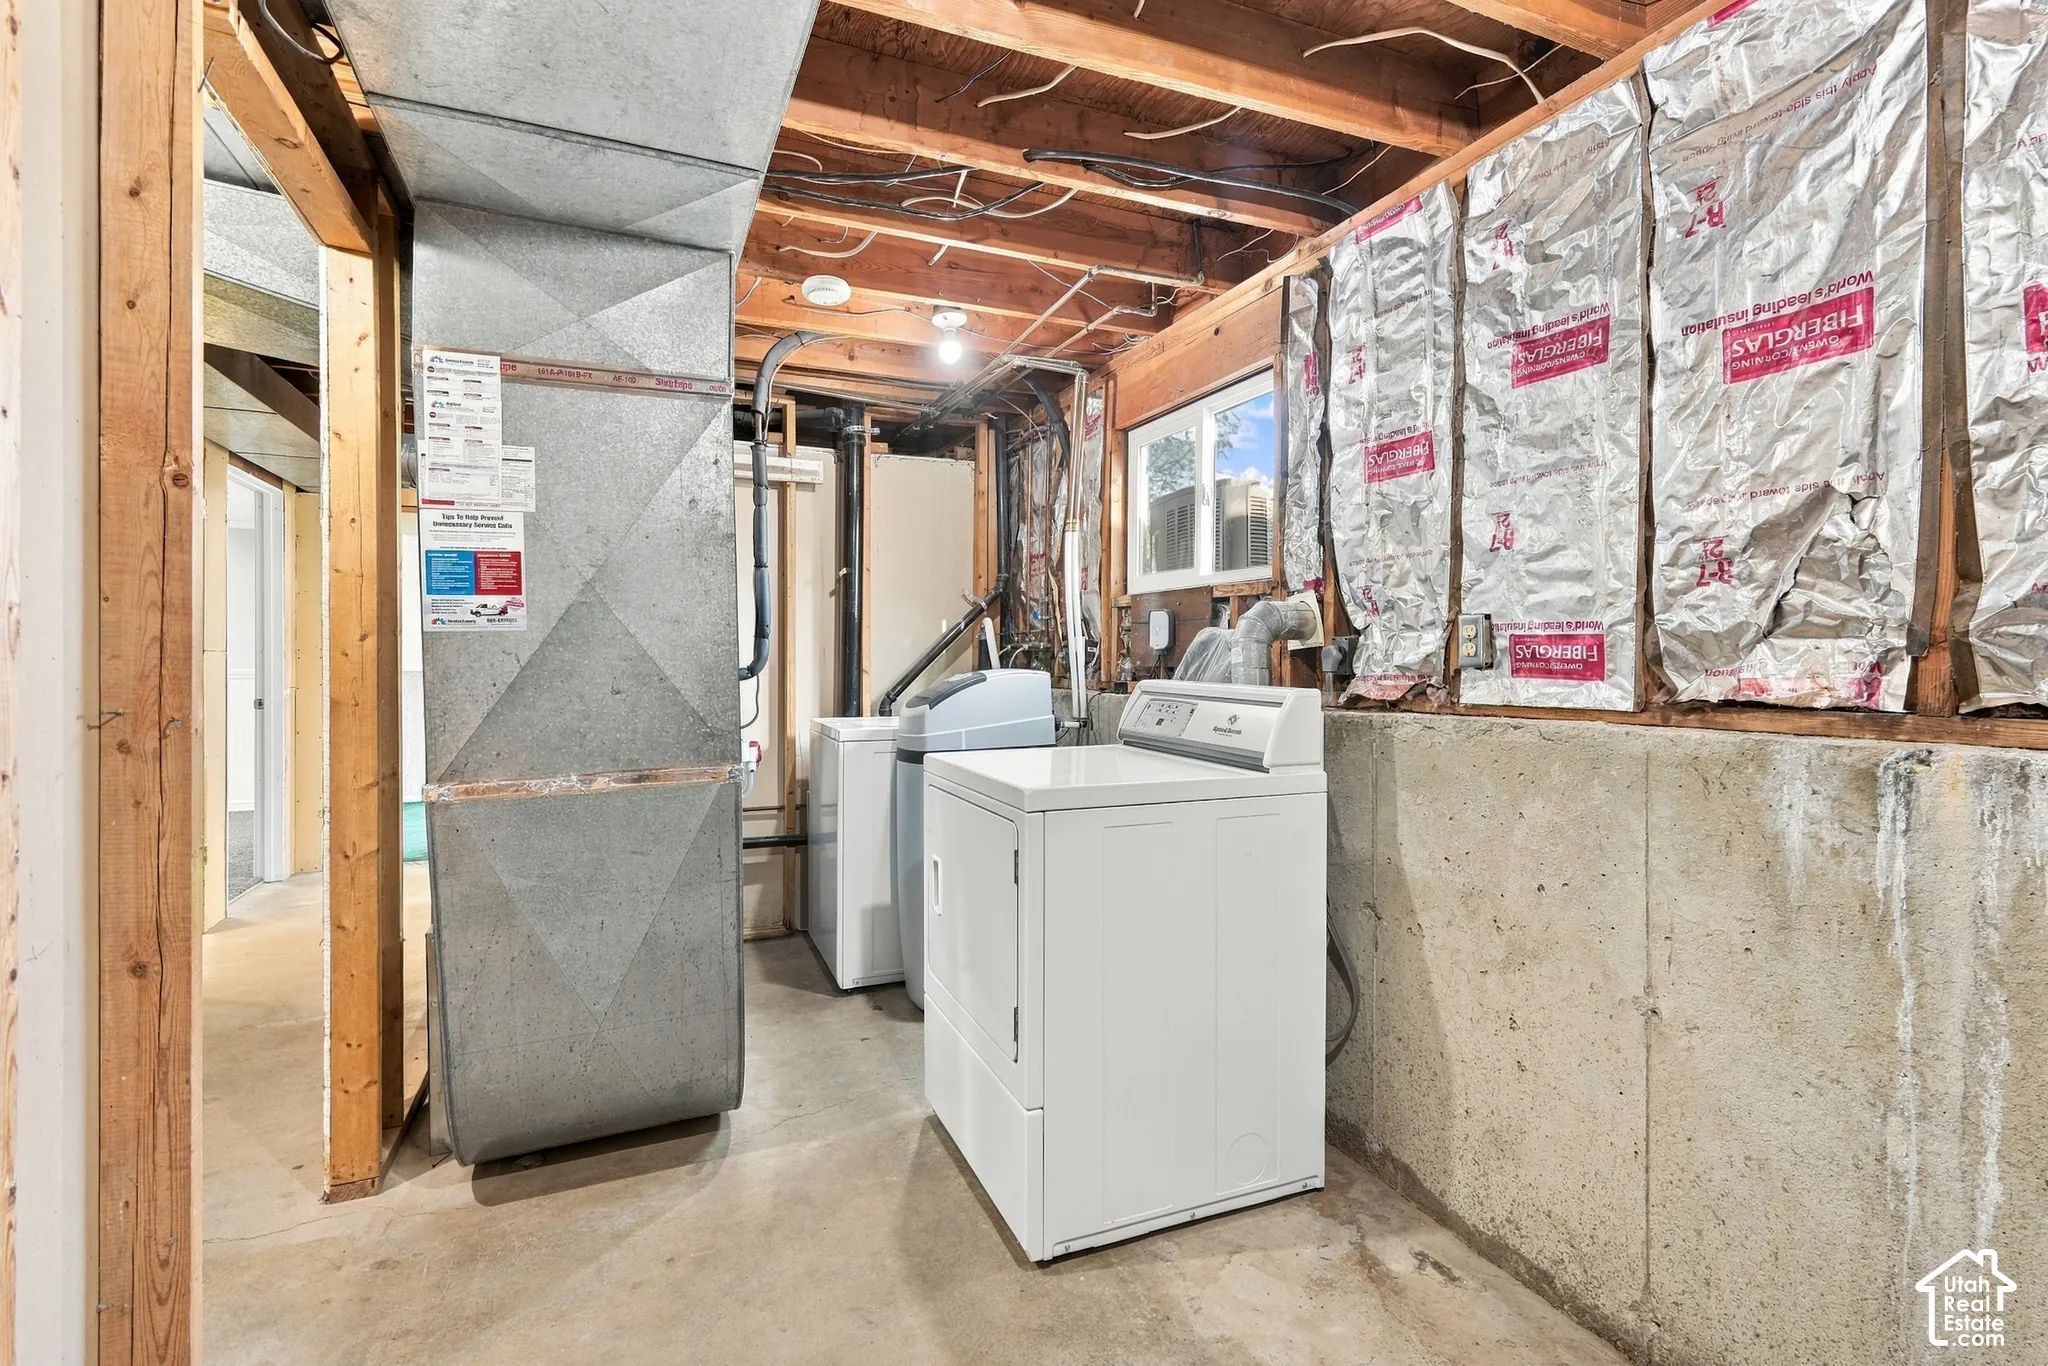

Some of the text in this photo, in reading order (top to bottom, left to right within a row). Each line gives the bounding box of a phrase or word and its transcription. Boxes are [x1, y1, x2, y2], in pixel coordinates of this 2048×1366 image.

[1842, 64, 1878, 89] Apply
[1816, 84, 1838, 100] this
[1786, 97, 1812, 113] side
[1814, 269, 1875, 300] World's
[1571, 301, 1611, 322] World's
[1752, 291, 1812, 315] leading
[1531, 316, 1570, 335] leading
[1681, 308, 1749, 337] insulation
[1731, 303, 1864, 358] FIBERGLAS
[1486, 329, 1531, 350] insulation
[1517, 328, 1603, 367] FIBERGLAS
[1368, 440, 1430, 467] FIBERGLAS
[1750, 486, 1790, 500] toward
[1794, 481, 1820, 492] side
[441, 513, 455, 521] Tips
[456, 513, 464, 521] To
[473, 521, 497, 529] Service
[1491, 620, 1605, 632] World's leading insulatio
[1515, 644, 1599, 662] FIBERGLAS
